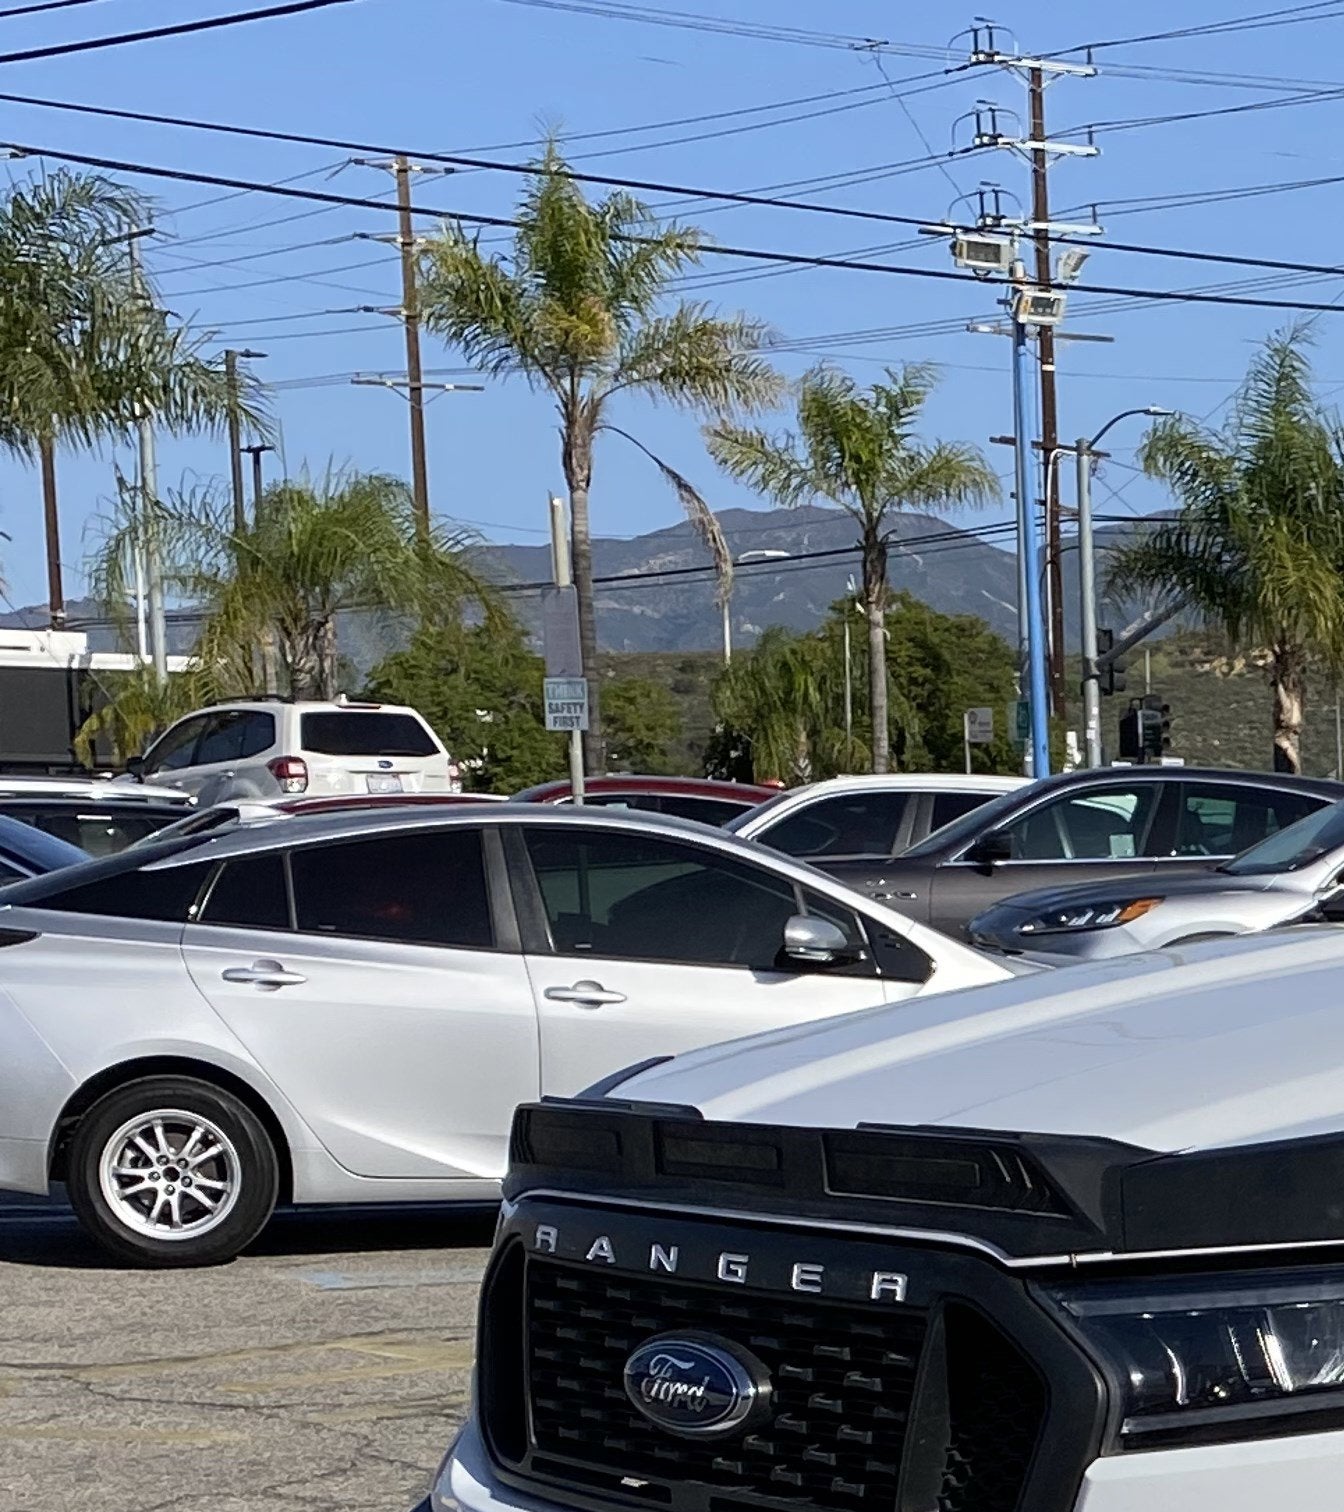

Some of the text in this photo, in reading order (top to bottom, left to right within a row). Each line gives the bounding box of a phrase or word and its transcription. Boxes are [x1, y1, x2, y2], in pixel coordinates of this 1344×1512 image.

[548, 702, 585, 714] SAFETY
[552, 715, 581, 728] FIRST
[534, 1223, 908, 1302] RANGER
[640, 1352, 709, 1412] Ford
